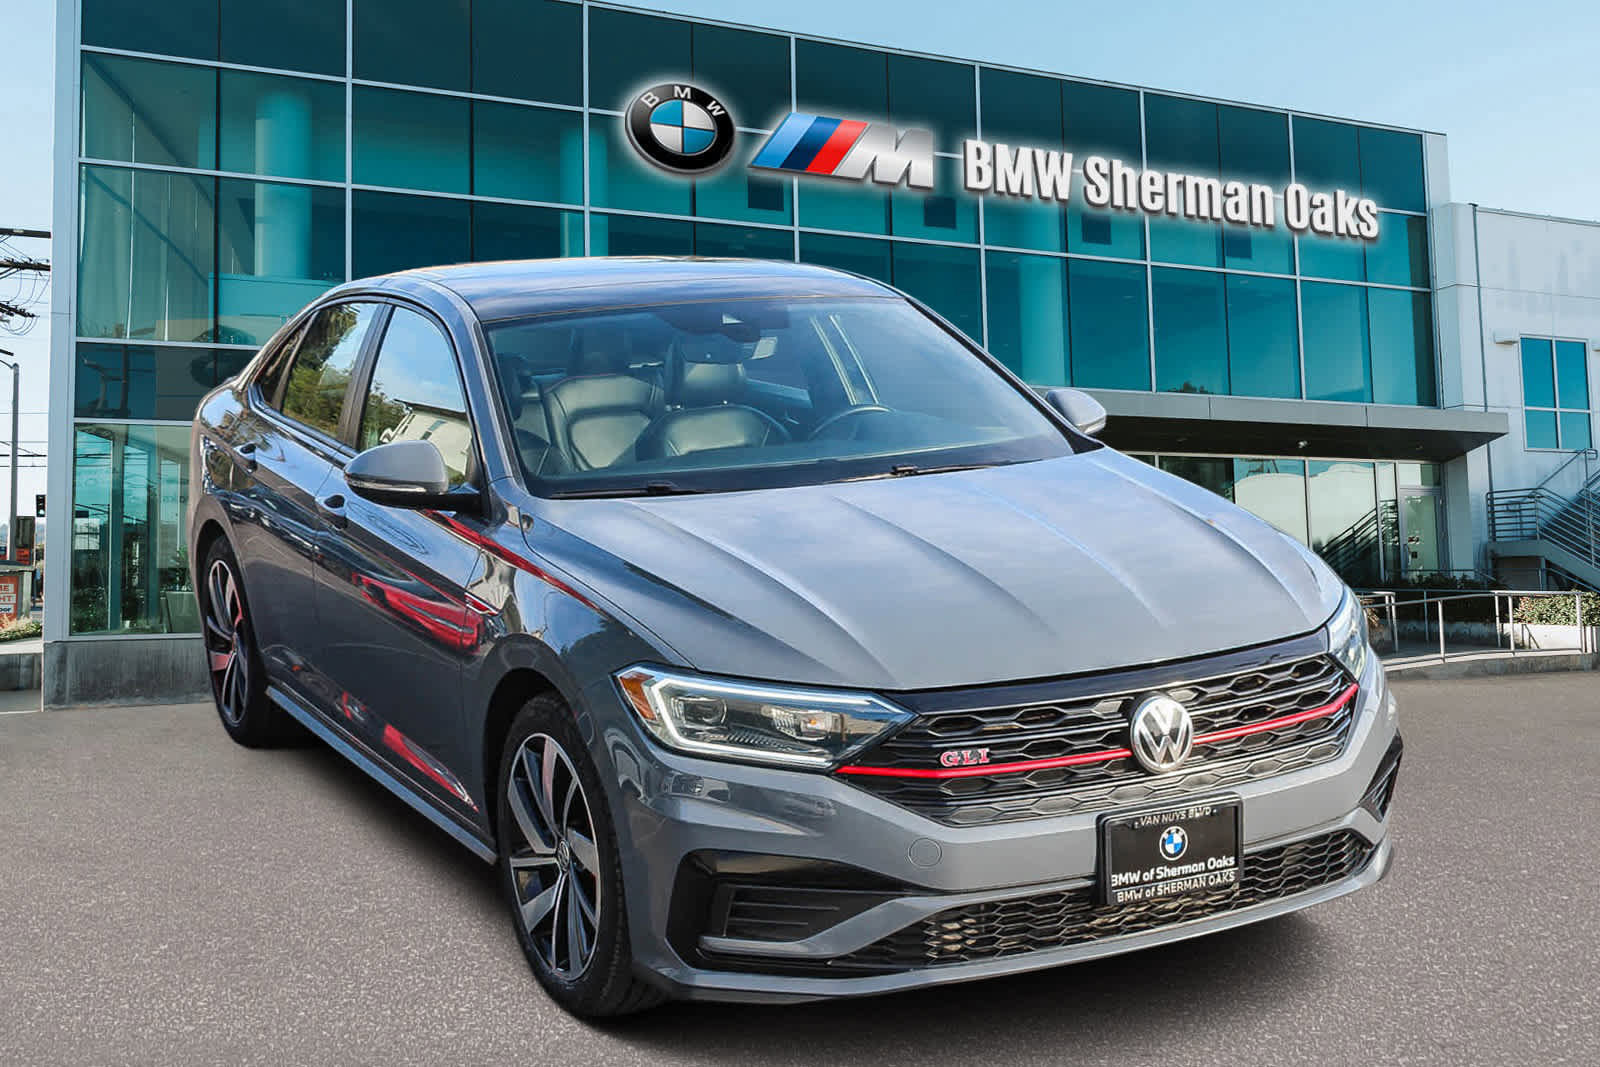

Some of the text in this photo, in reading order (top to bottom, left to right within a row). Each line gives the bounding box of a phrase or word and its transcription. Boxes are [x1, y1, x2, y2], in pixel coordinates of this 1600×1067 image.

[640, 84, 725, 118] BMW
[963, 138, 1380, 241] BMW Sherman Oaks
[939, 748, 990, 767] GLI
[1140, 806, 1211, 827] VAN NUYS BLVD
[1111, 855, 1235, 887] BMW of Sherman Oaks
[1117, 871, 1235, 903] BMW of SHERMAN OAKS
